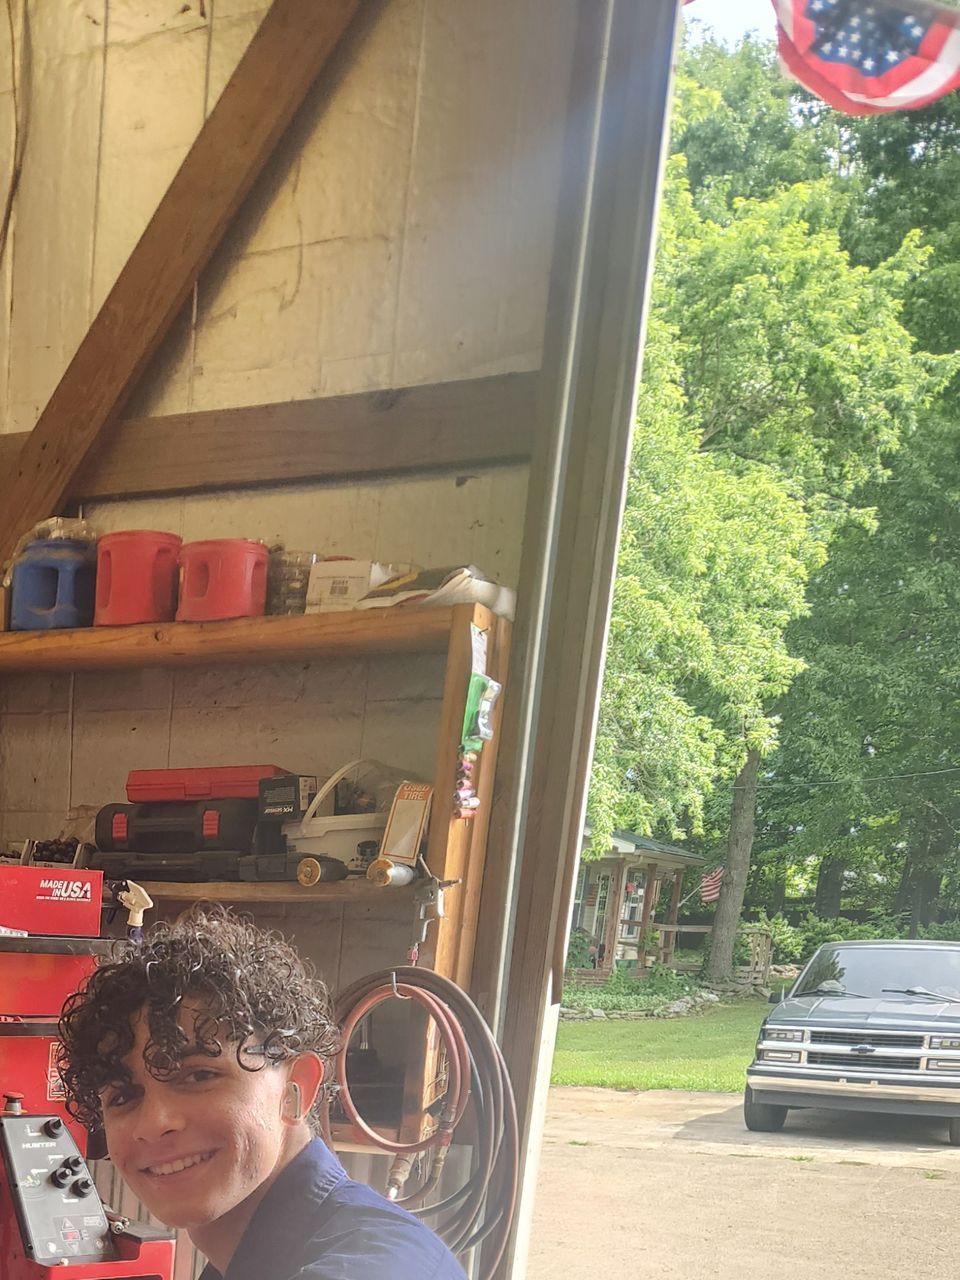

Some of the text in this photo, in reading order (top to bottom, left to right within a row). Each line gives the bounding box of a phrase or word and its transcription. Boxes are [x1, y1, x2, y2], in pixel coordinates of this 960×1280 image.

[404, 791, 425, 801] TIRE
[40, 879, 91, 898] MADE IN USA
[22, 1141, 57, 1149] HUNTER
